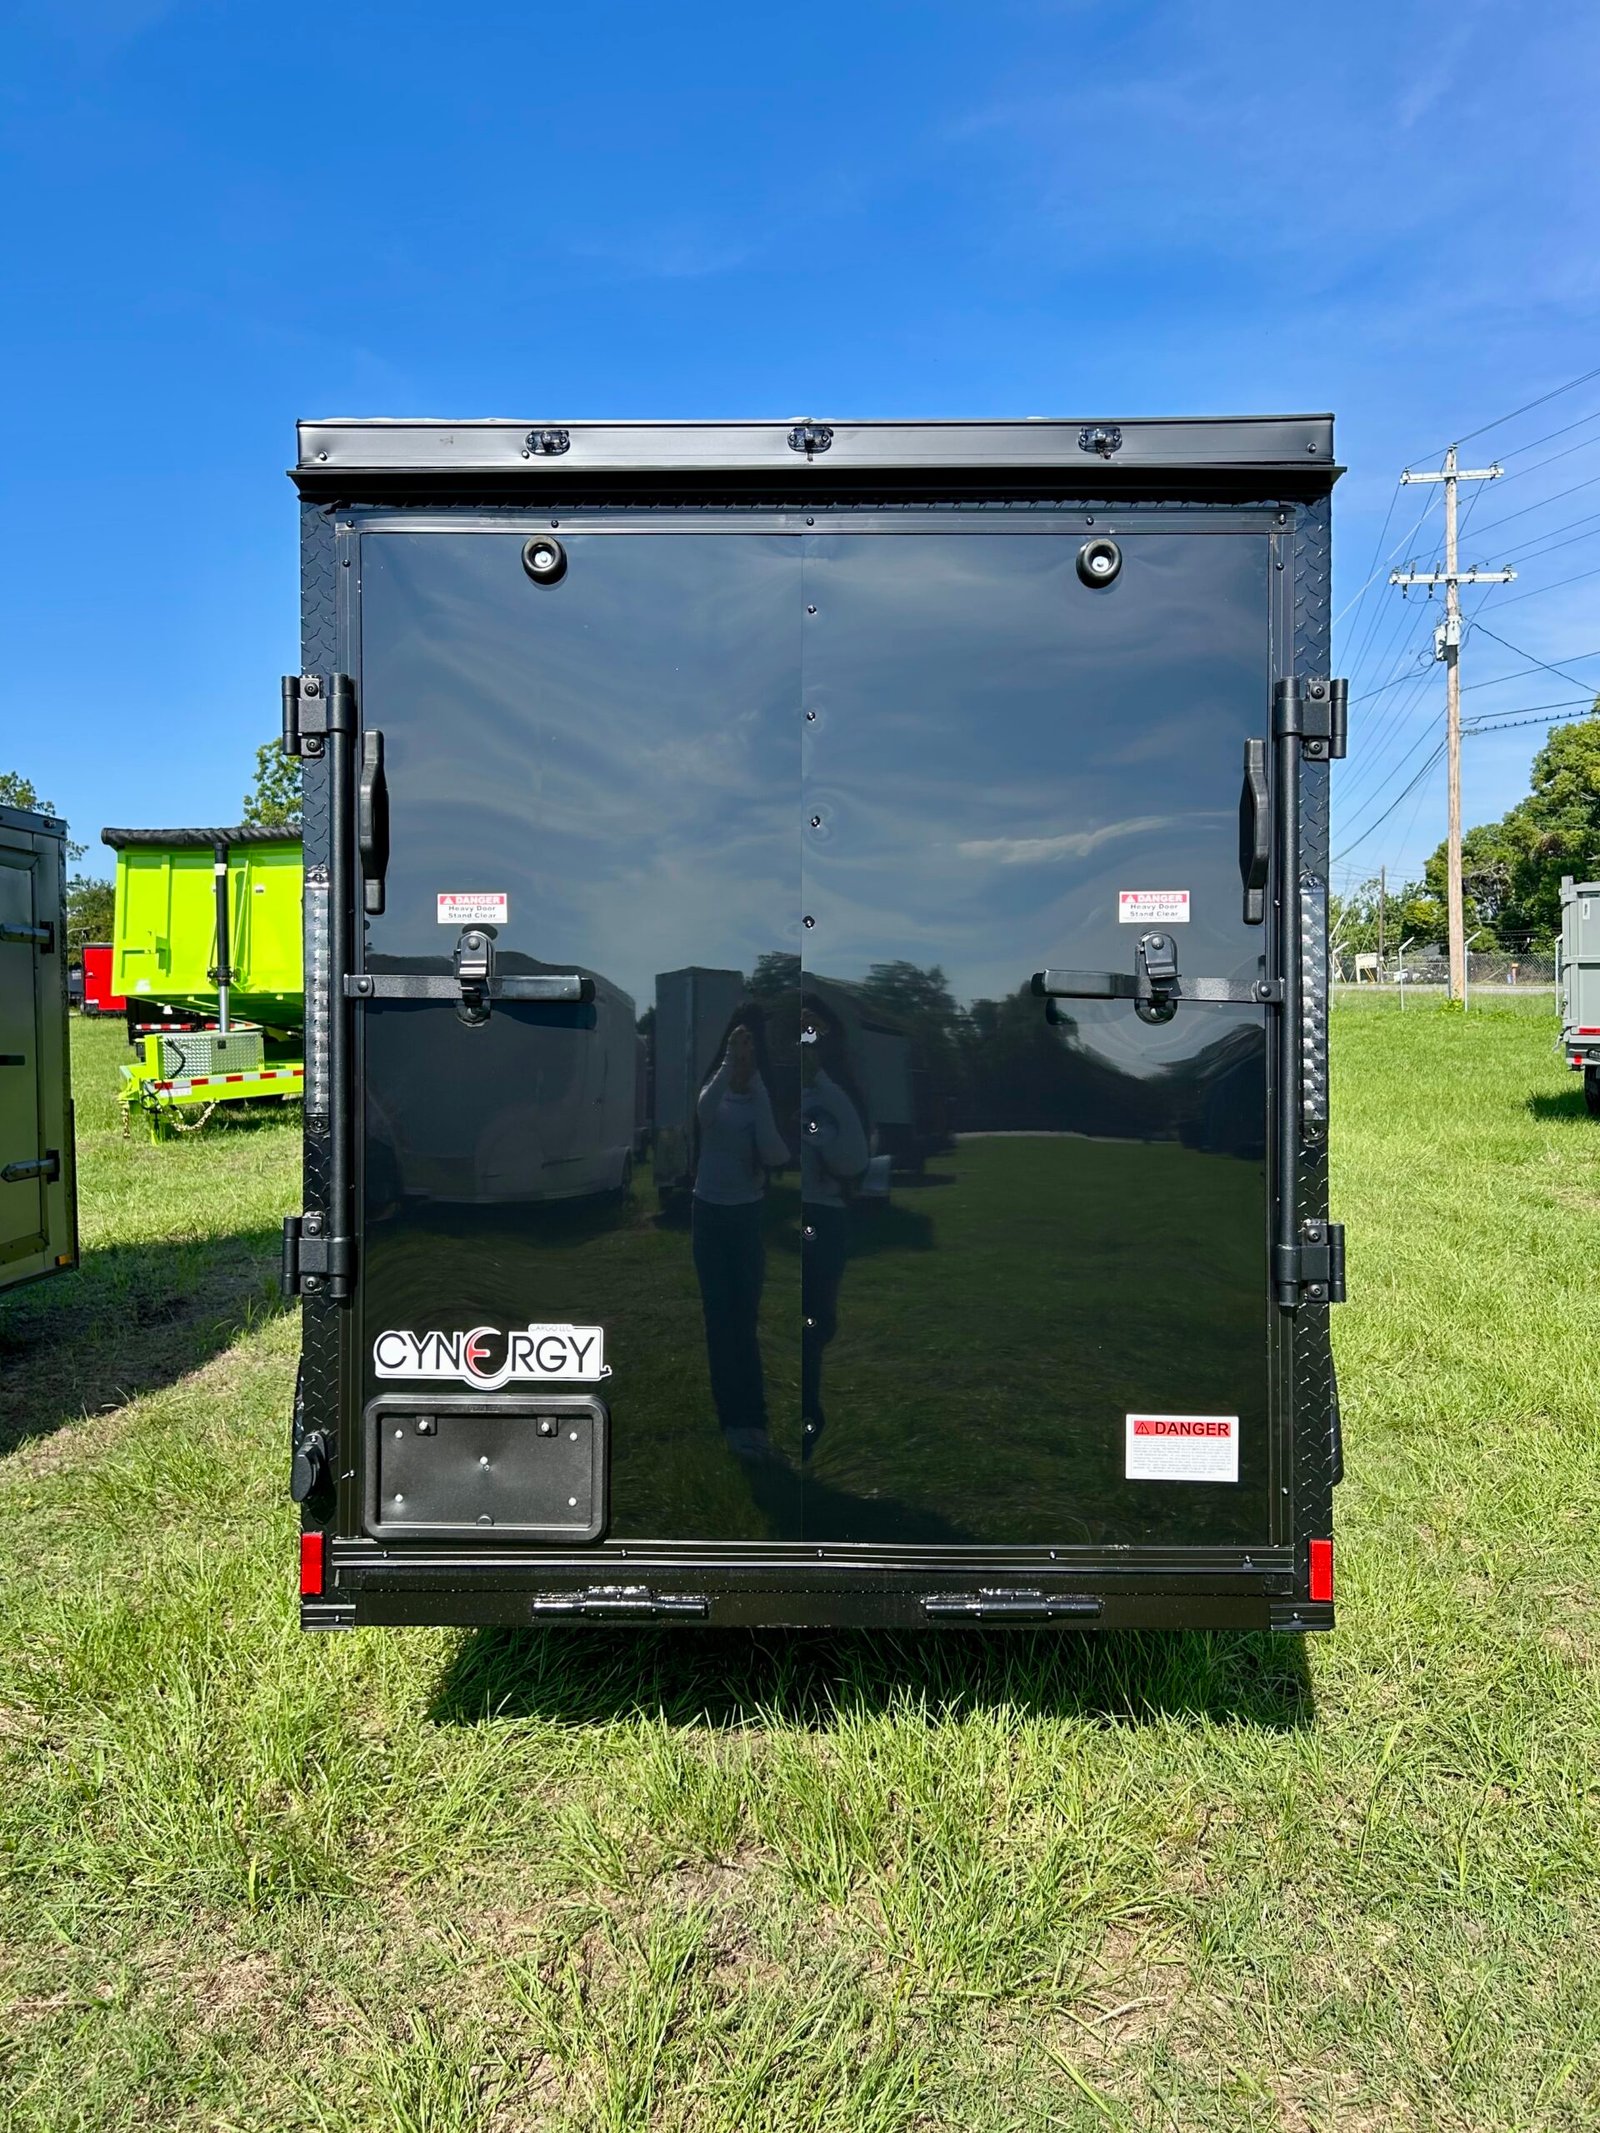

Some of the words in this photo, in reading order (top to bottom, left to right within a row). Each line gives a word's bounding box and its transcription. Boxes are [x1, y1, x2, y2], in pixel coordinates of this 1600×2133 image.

[455, 896, 500, 904] DANGER
[1137, 894, 1182, 903] DANGER
[376, 1328, 596, 1379] CYNERGY
[1155, 1421, 1229, 1436] DANGER
